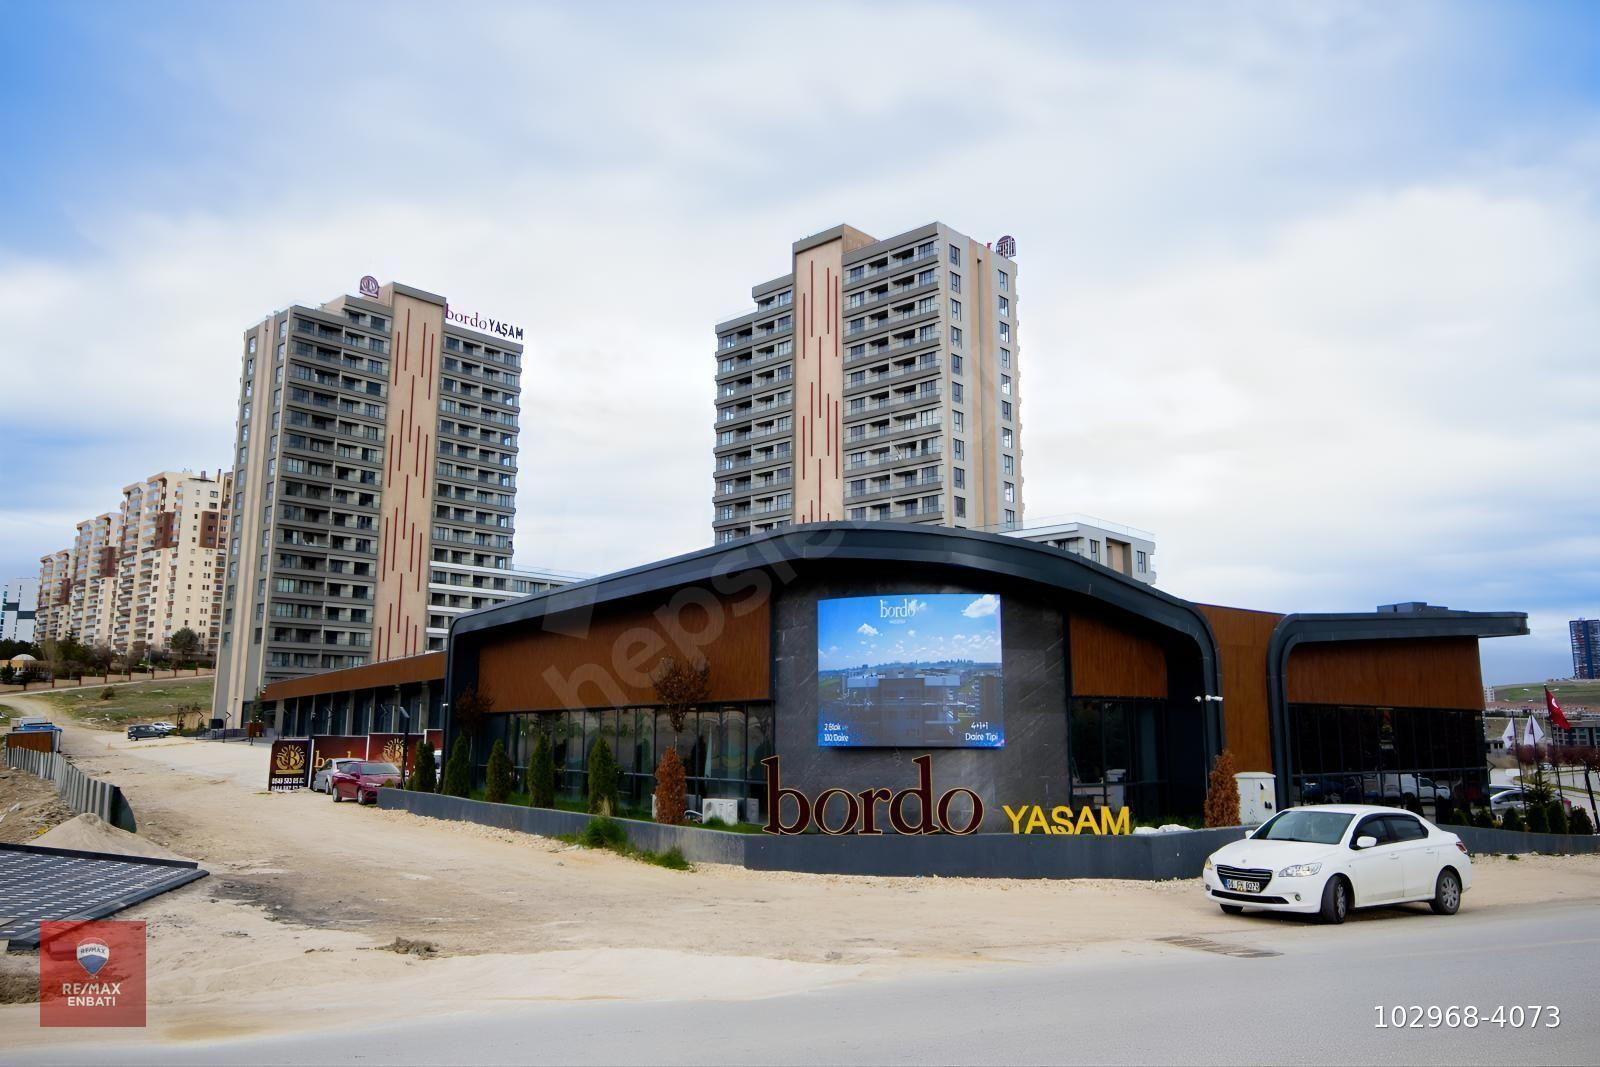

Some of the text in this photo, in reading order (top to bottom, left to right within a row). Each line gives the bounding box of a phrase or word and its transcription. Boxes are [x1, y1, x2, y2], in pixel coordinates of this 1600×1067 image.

[445, 302, 524, 341] bordo YAŞAM
[880, 599, 916, 618] bordo
[760, 753, 984, 836] bordo
